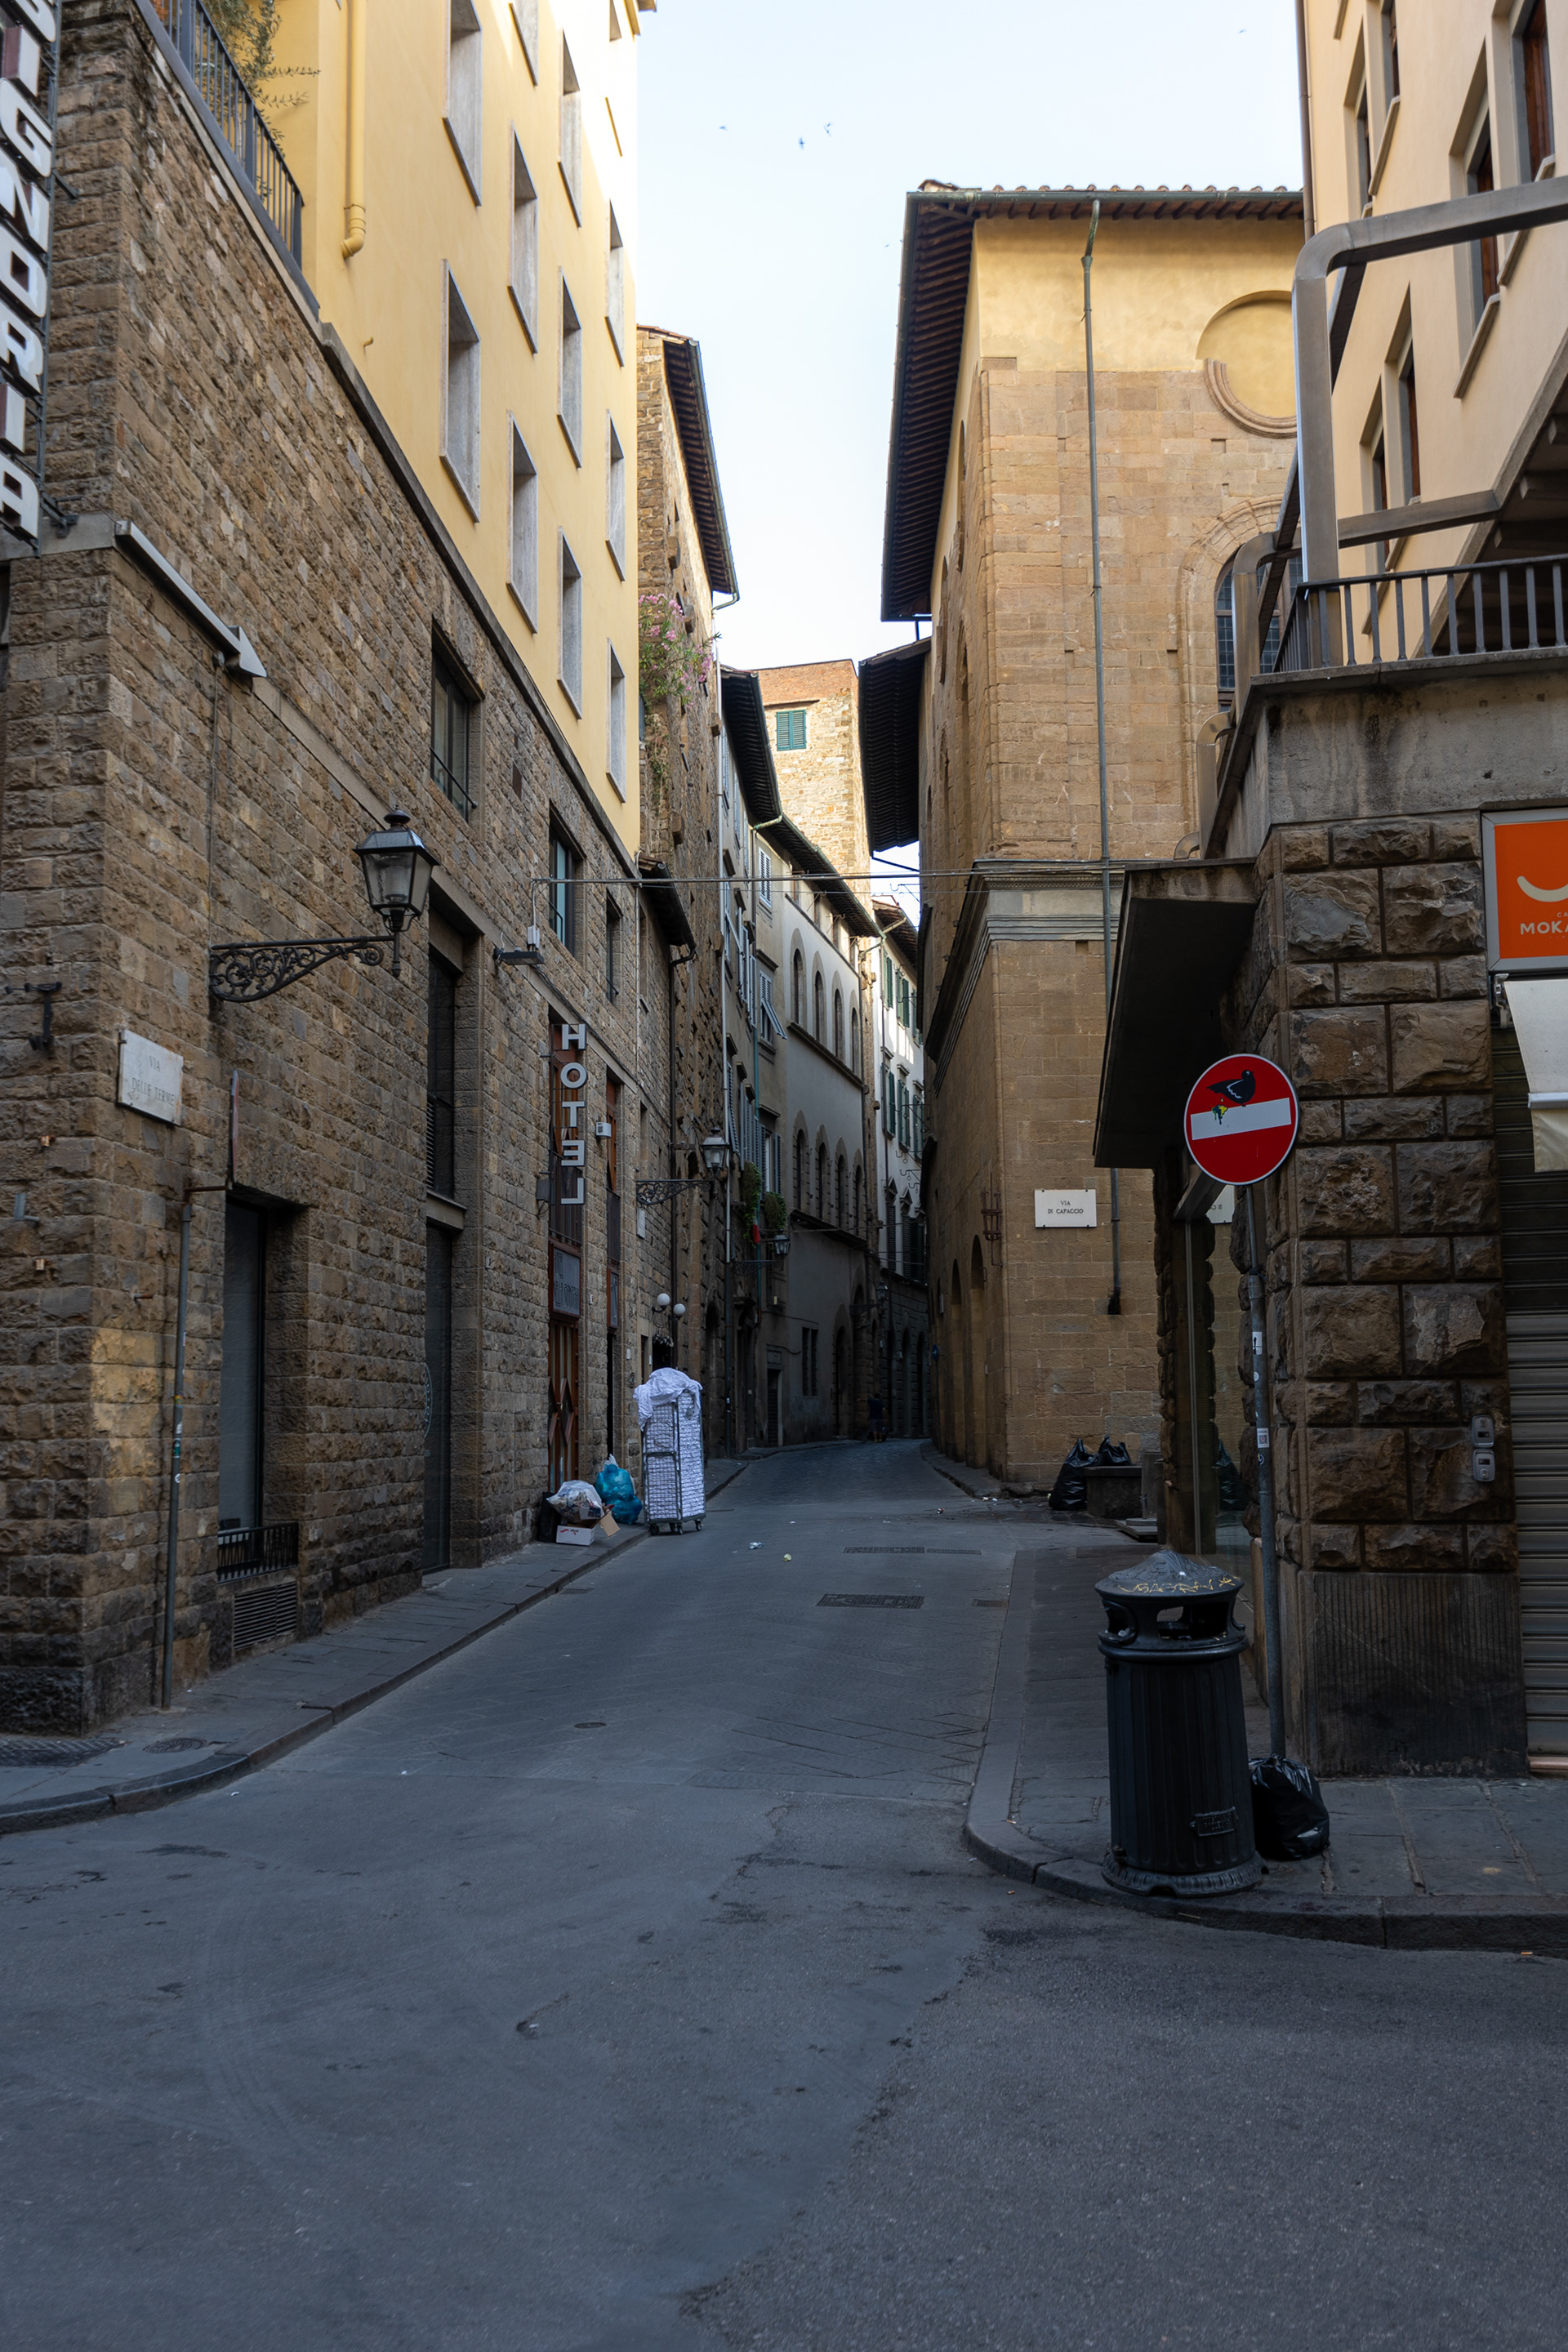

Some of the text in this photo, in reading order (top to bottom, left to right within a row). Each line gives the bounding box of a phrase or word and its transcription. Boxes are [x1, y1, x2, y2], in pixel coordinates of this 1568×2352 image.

[1521, 920, 1568, 934] MOK
[149, 1055, 161, 1071] VIA
[131, 1077, 176, 1107] DELLE TERME
